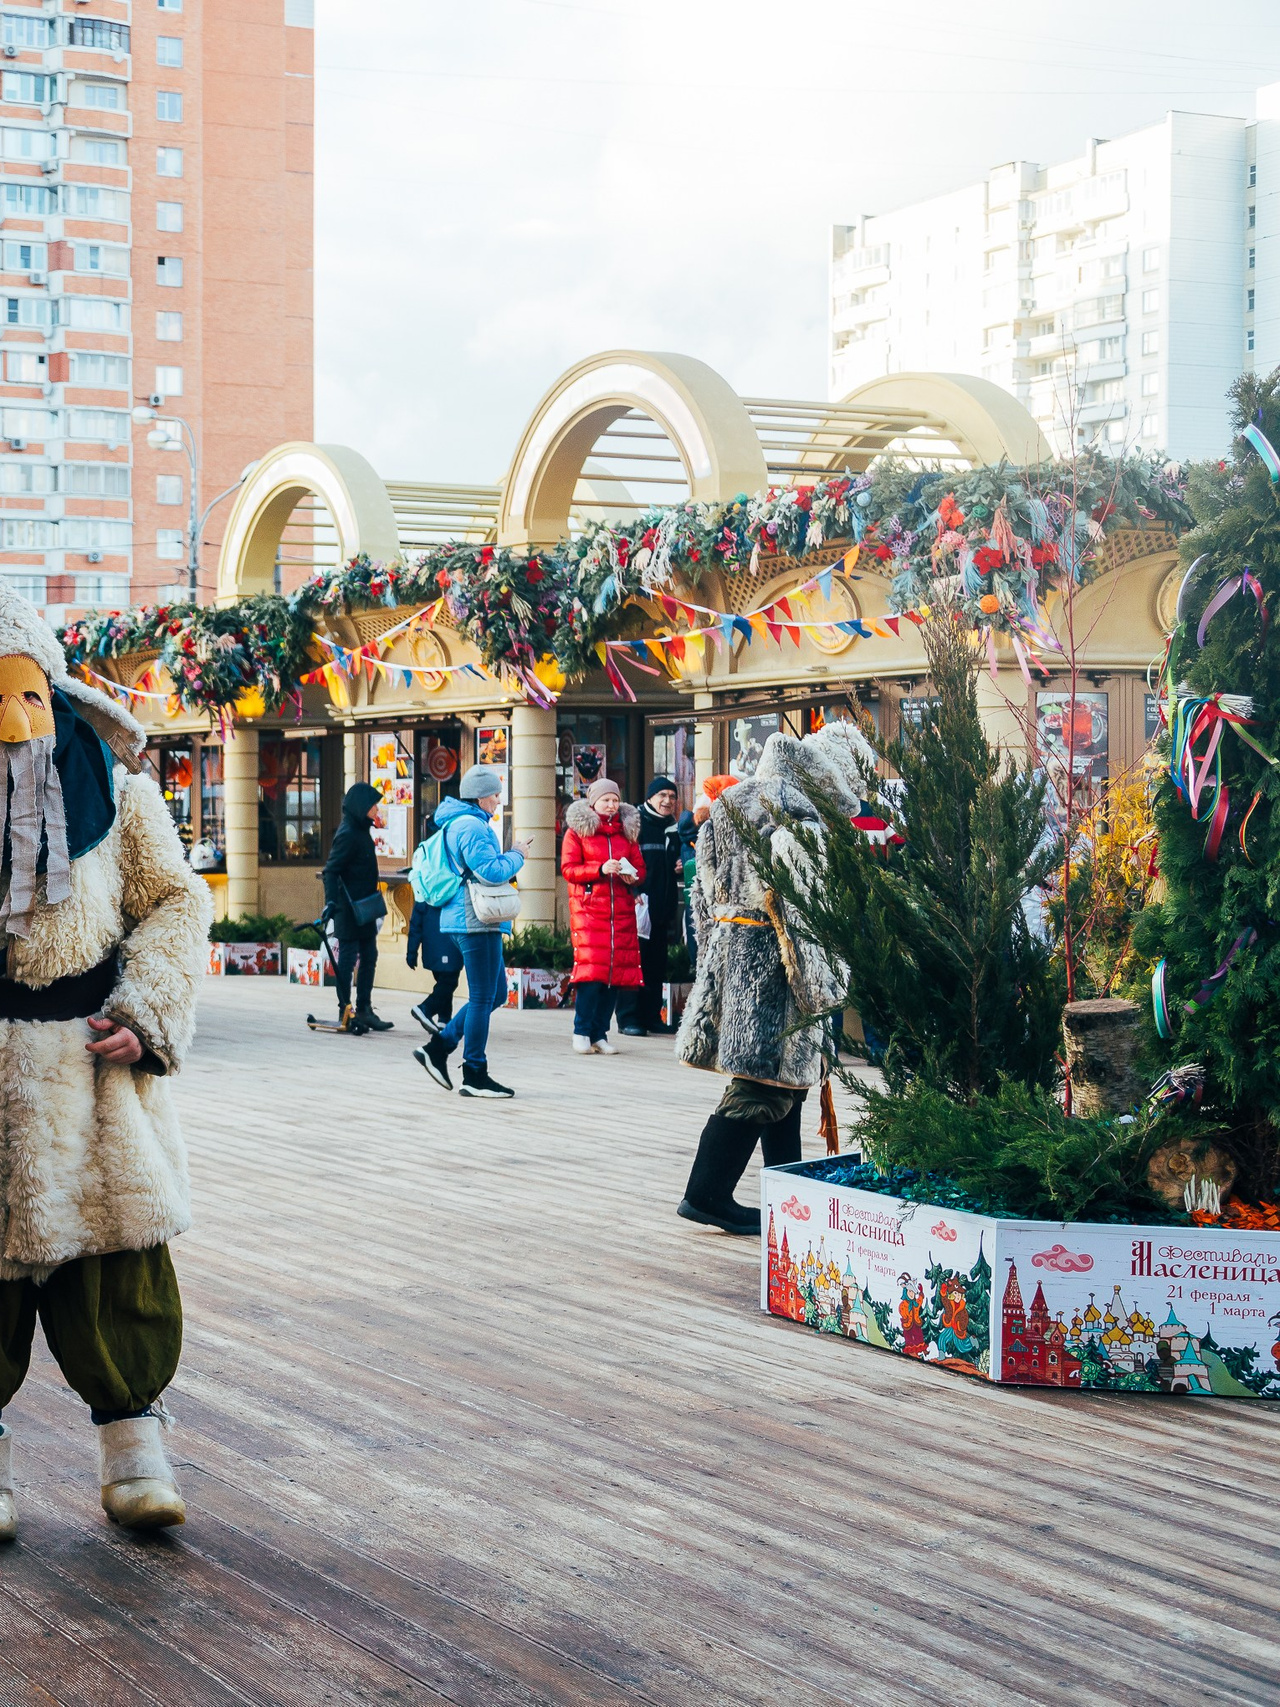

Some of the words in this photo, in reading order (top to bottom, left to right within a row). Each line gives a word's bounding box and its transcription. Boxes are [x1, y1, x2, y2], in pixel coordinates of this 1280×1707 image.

[829, 1197, 905, 1247] Масленица
[846, 1240, 855, 1252] 21
[858, 1246, 888, 1260] февраля
[1158, 1245, 1277, 1267] Фестиваль
[874, 1264, 896, 1277] марта
[1130, 1240, 1280, 1285] Масленица
[1166, 1285, 1183, 1299] 21
[1190, 1289, 1251, 1304] февраля
[1209, 1302, 1216, 1315] 1
[1223, 1307, 1266, 1319] марта
